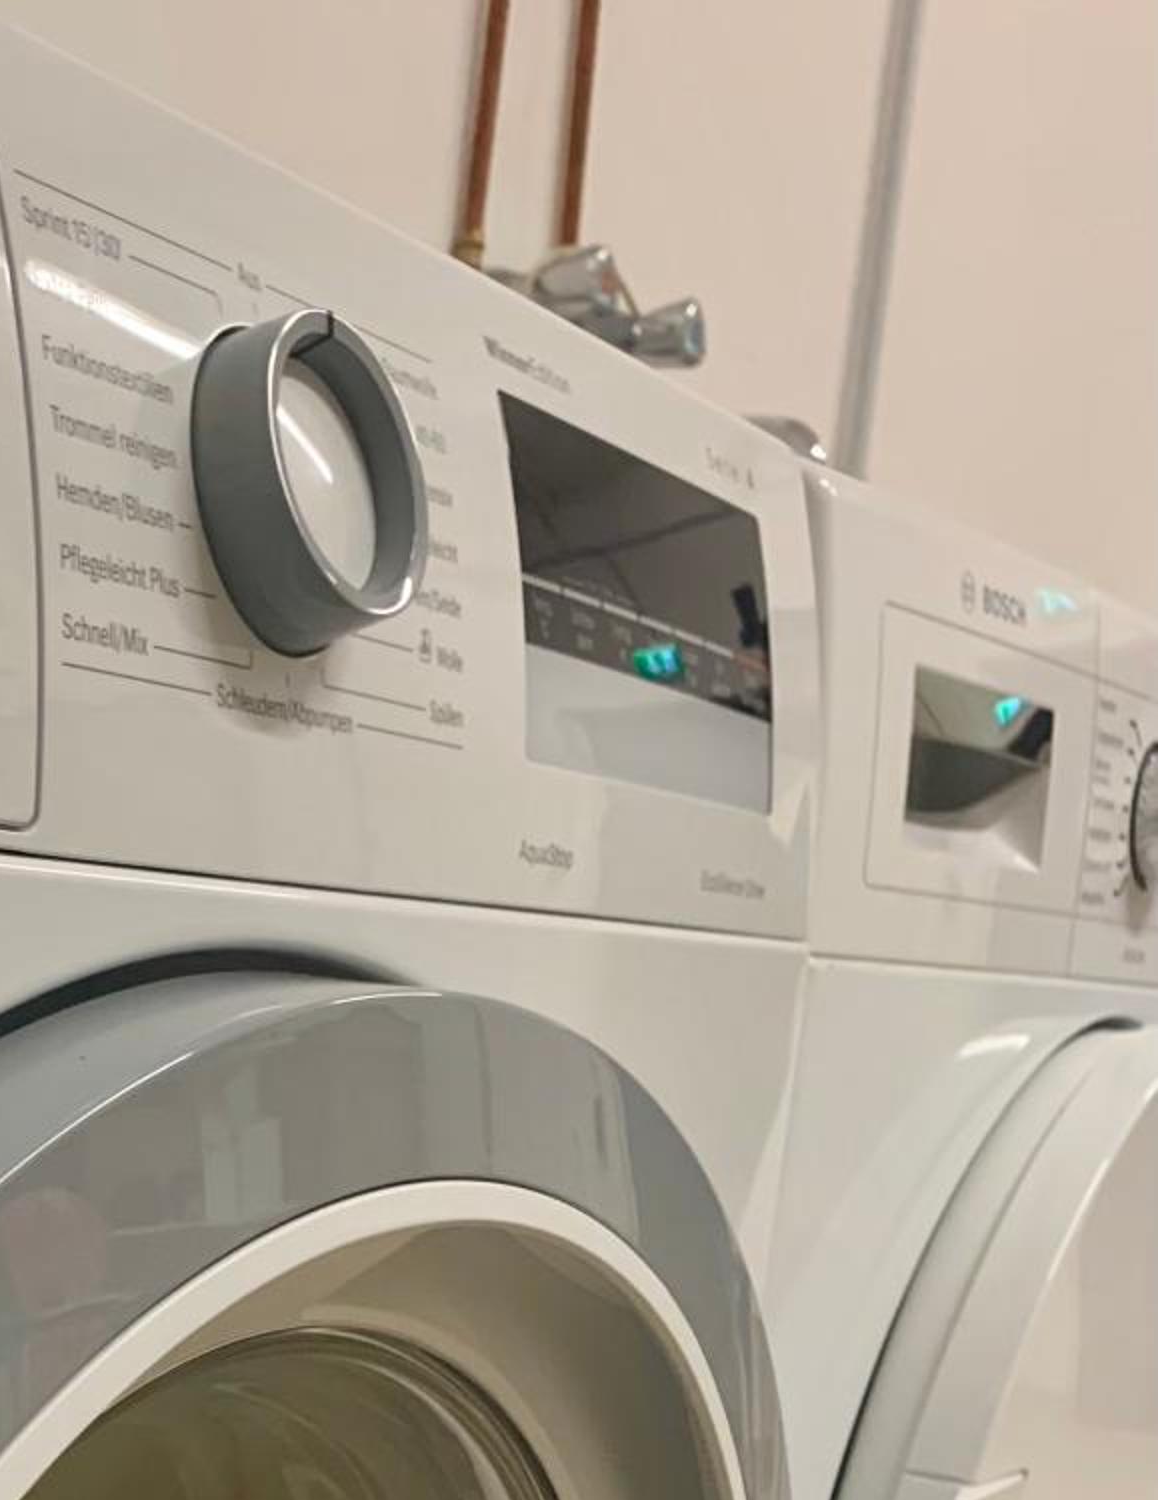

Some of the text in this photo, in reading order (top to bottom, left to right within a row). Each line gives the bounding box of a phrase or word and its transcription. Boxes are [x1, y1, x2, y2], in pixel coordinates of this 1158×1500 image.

[49, 403, 117, 449] Trommel
[55, 472, 174, 532] Hemden/Blusen
[59, 542, 180, 599] Pflegeleicht Plus
[983, 585, 1028, 629] BOSCH
[60, 611, 150, 657] Schnell/Mix
